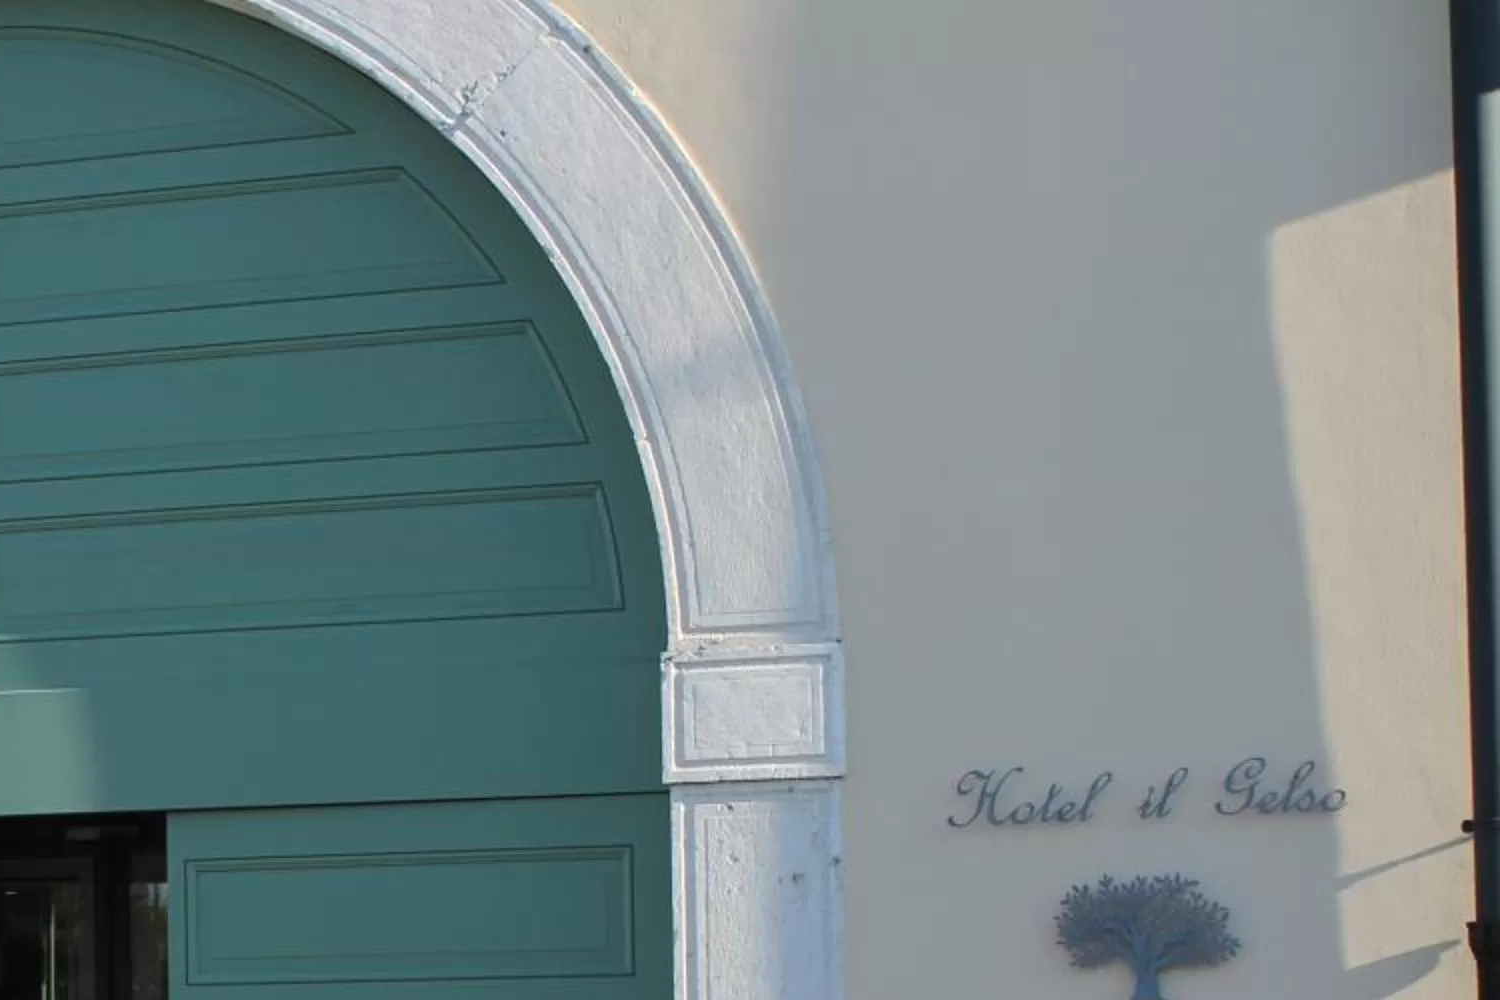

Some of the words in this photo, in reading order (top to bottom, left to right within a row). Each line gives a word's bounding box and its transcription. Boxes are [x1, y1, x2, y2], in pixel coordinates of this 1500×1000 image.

[948, 766, 1113, 828] Hotel
[1140, 767, 1189, 819] il
[1215, 757, 1348, 816] Gelso
